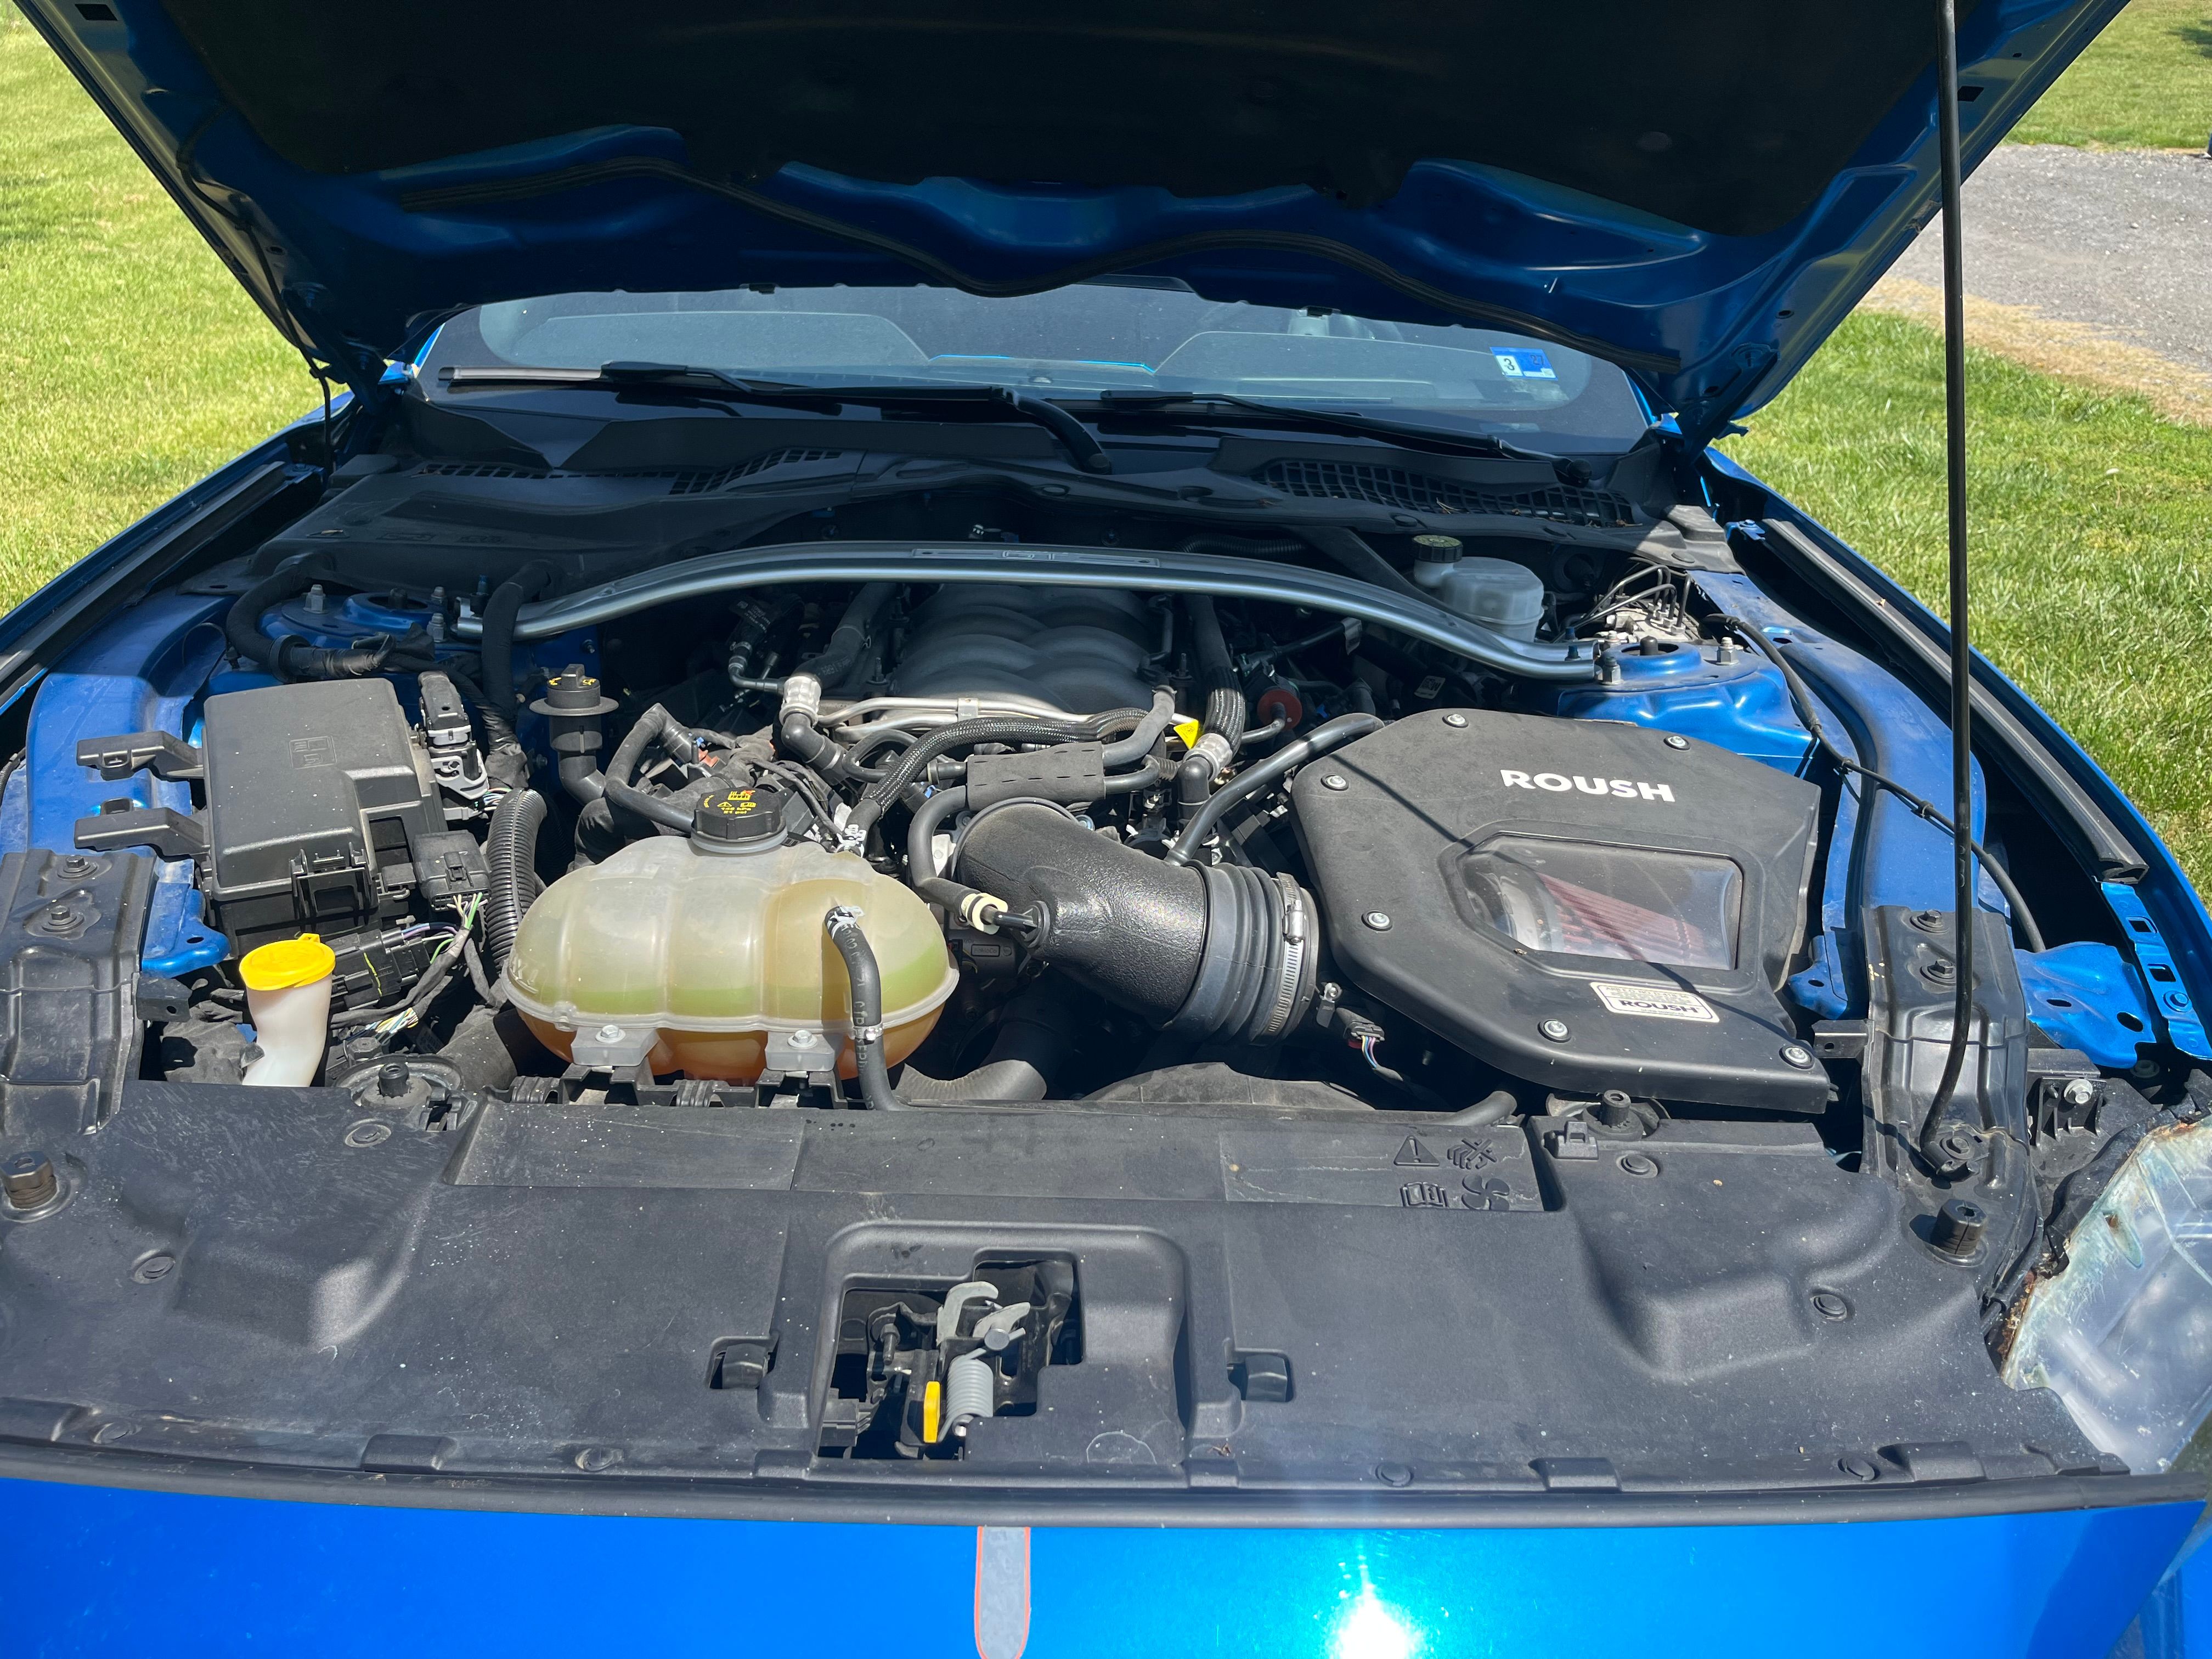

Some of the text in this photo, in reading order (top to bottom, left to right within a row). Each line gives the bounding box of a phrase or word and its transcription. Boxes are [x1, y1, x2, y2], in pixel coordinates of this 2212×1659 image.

[1504, 358, 1515, 370] 3
[1500, 769, 1675, 802] ROUSH
[1619, 1000, 1699, 1013] ROUSH
